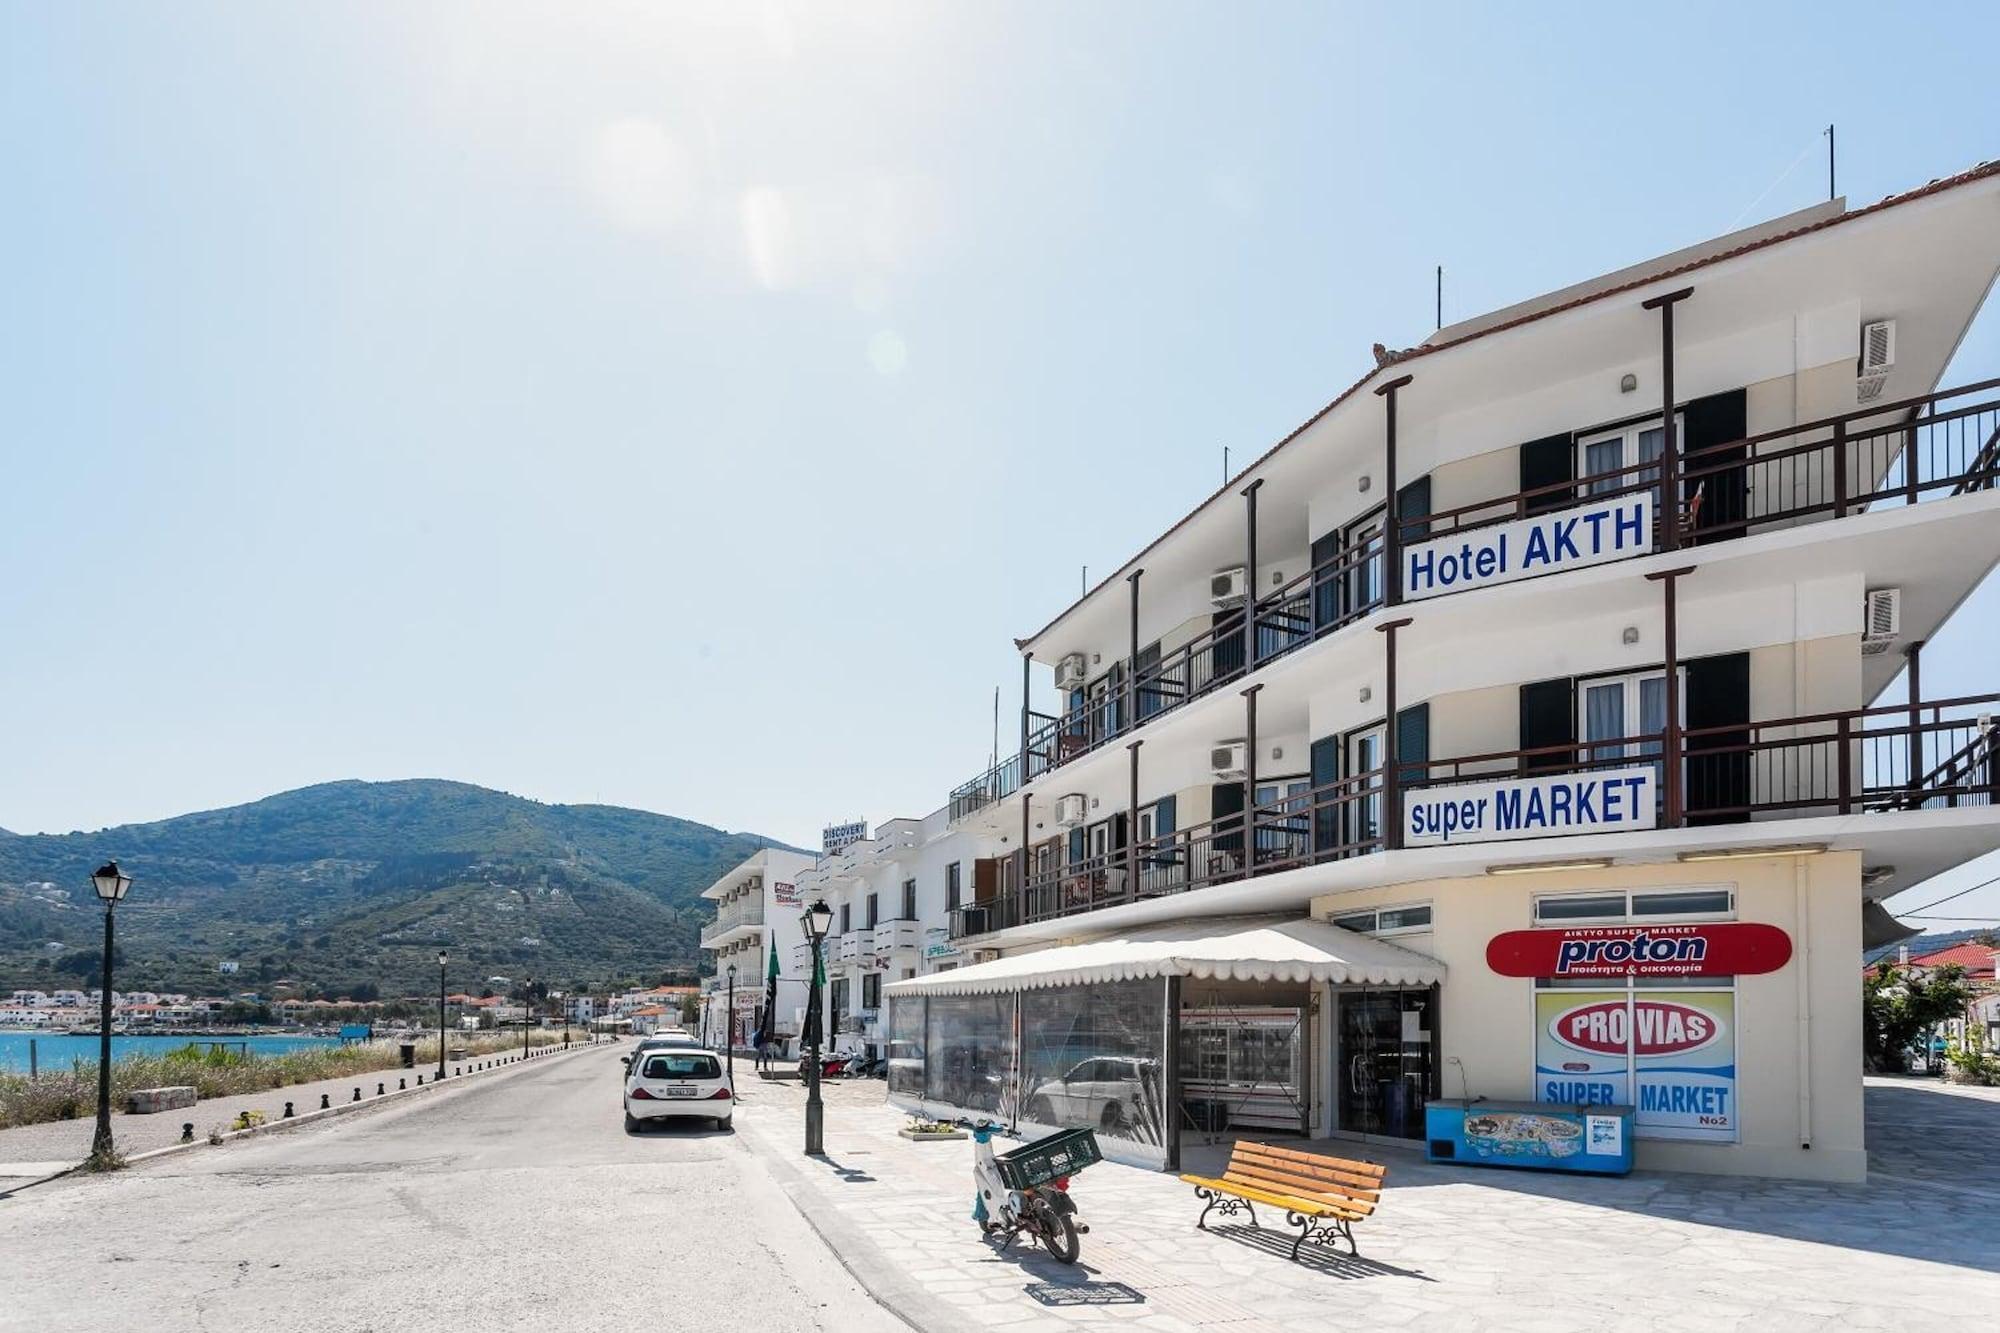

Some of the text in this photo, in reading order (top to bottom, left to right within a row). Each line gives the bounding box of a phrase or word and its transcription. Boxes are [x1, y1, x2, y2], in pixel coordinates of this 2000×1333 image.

[1411, 503, 1642, 591] Hotel AKTH
[1411, 776, 1646, 841] super MARKET
[823, 822, 865, 840] DISCOVERY
[824, 838, 842, 848] RENT
[1606, 928, 1642, 936] SUPER
[1555, 931, 1708, 974] proton
[1570, 963, 1702, 975] ποιότητα & οικονομία
[1546, 1081, 1729, 1115] SUPER MARKET
[1699, 1116, 1728, 1125] No2
